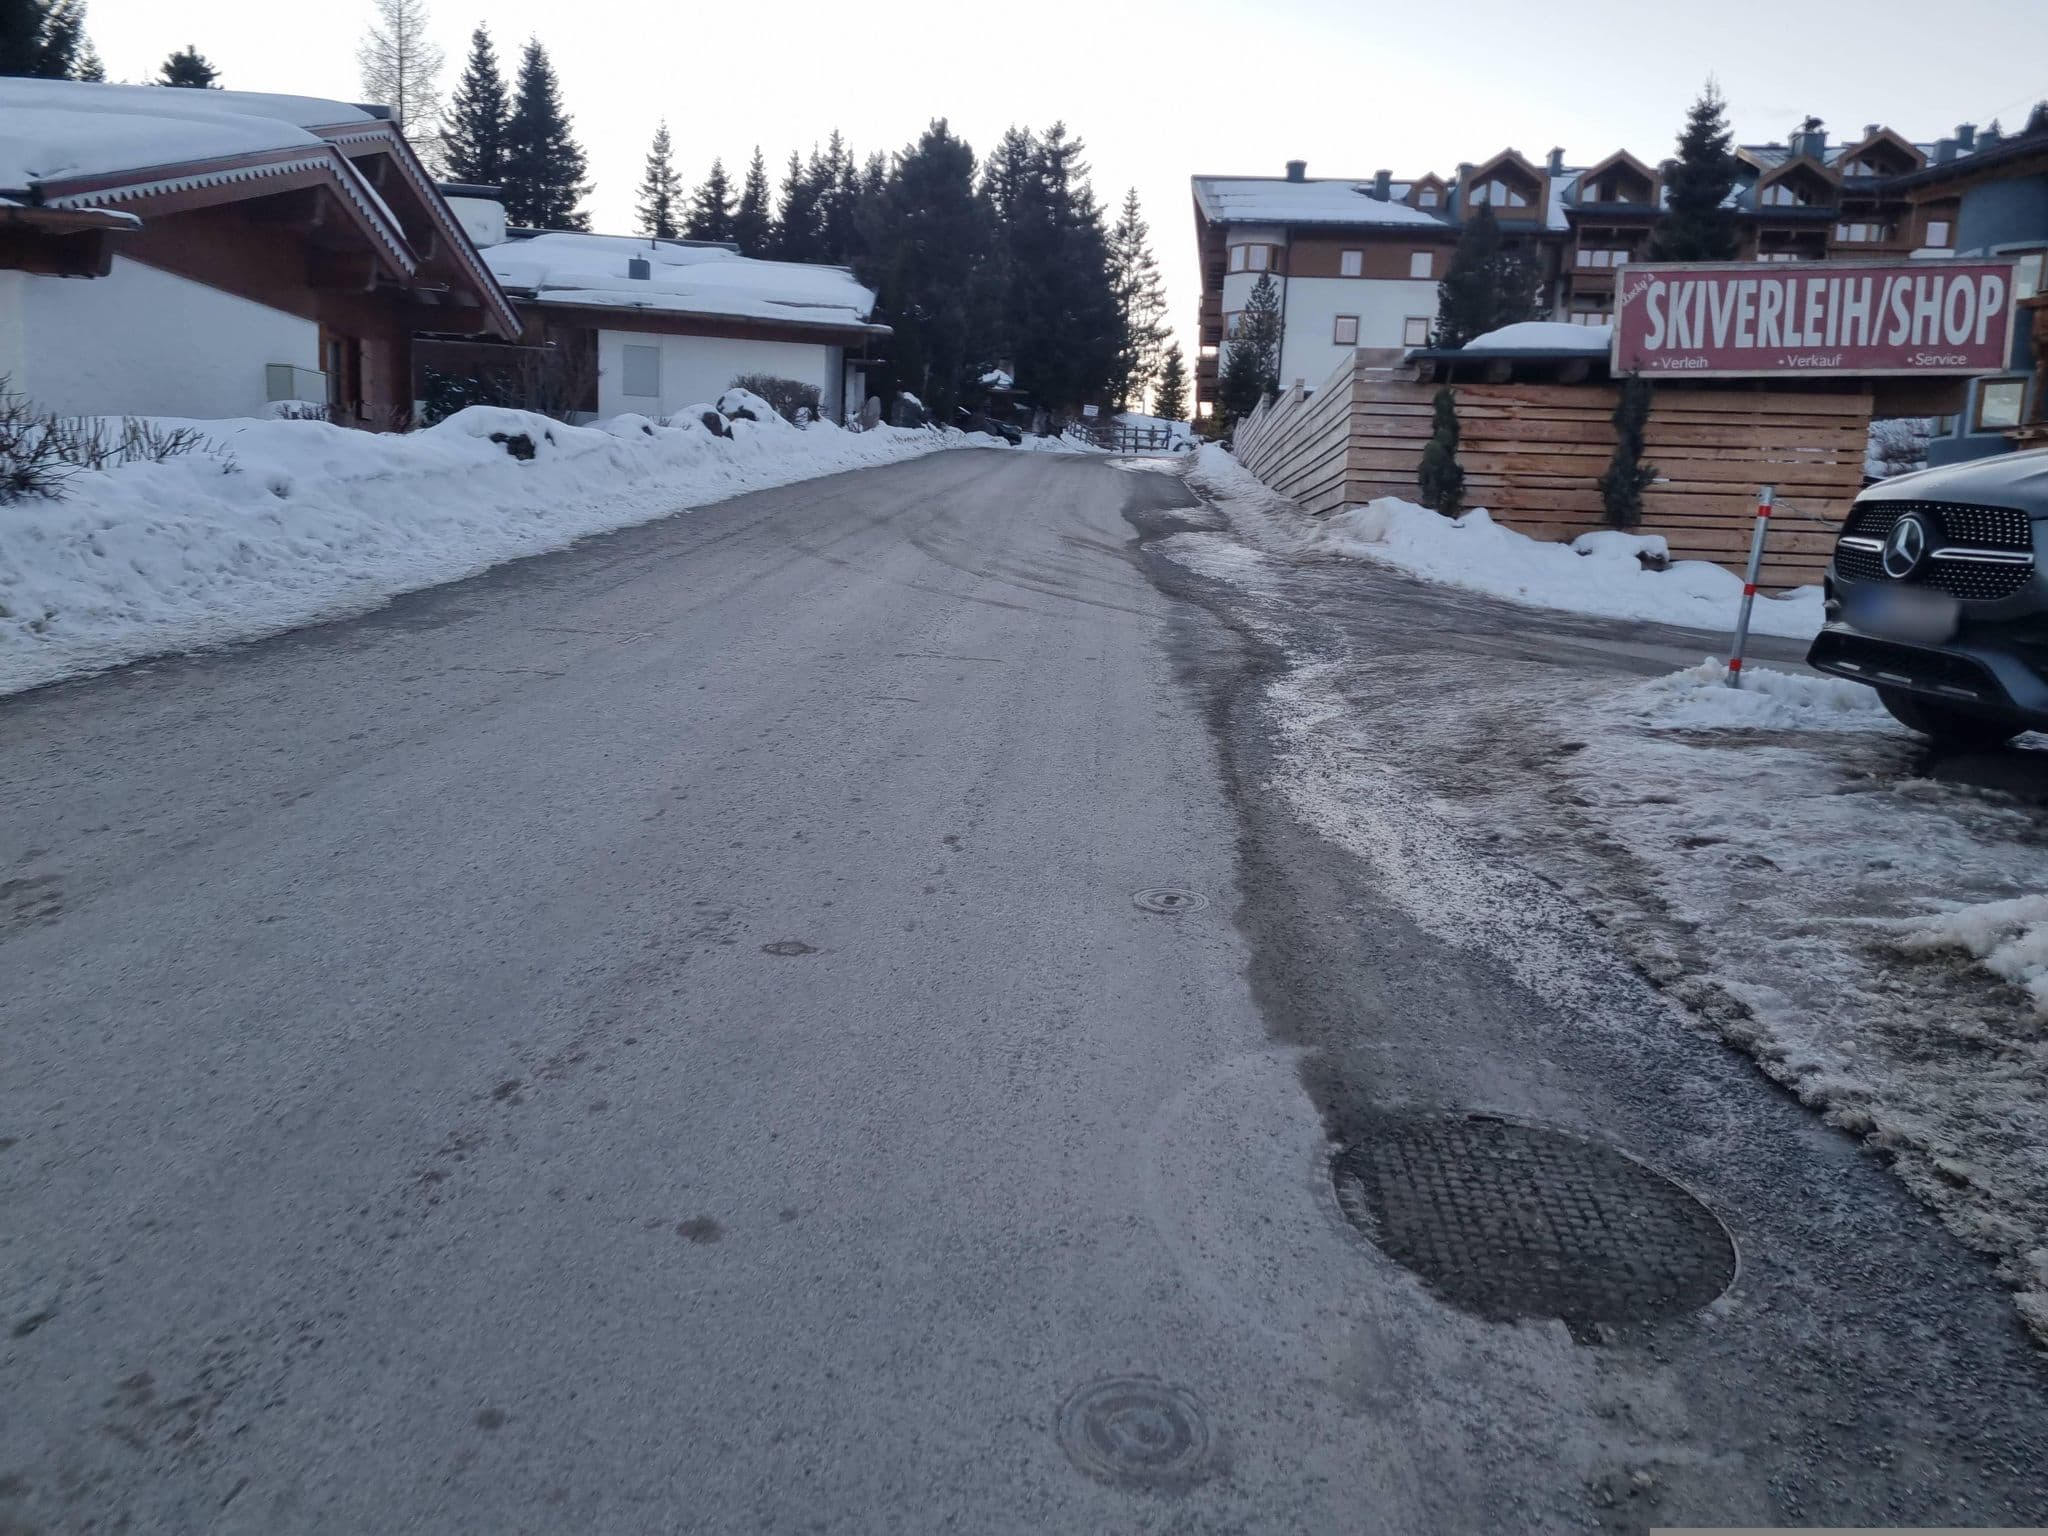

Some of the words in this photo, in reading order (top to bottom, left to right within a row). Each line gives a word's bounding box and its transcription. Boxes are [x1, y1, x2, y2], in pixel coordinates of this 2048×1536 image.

[1644, 275, 2005, 350] SKIVERLEIH/SHOP
[1660, 356, 1709, 370] Verleih
[1787, 353, 1843, 368] Verkauf
[1915, 352, 1967, 367] Service
